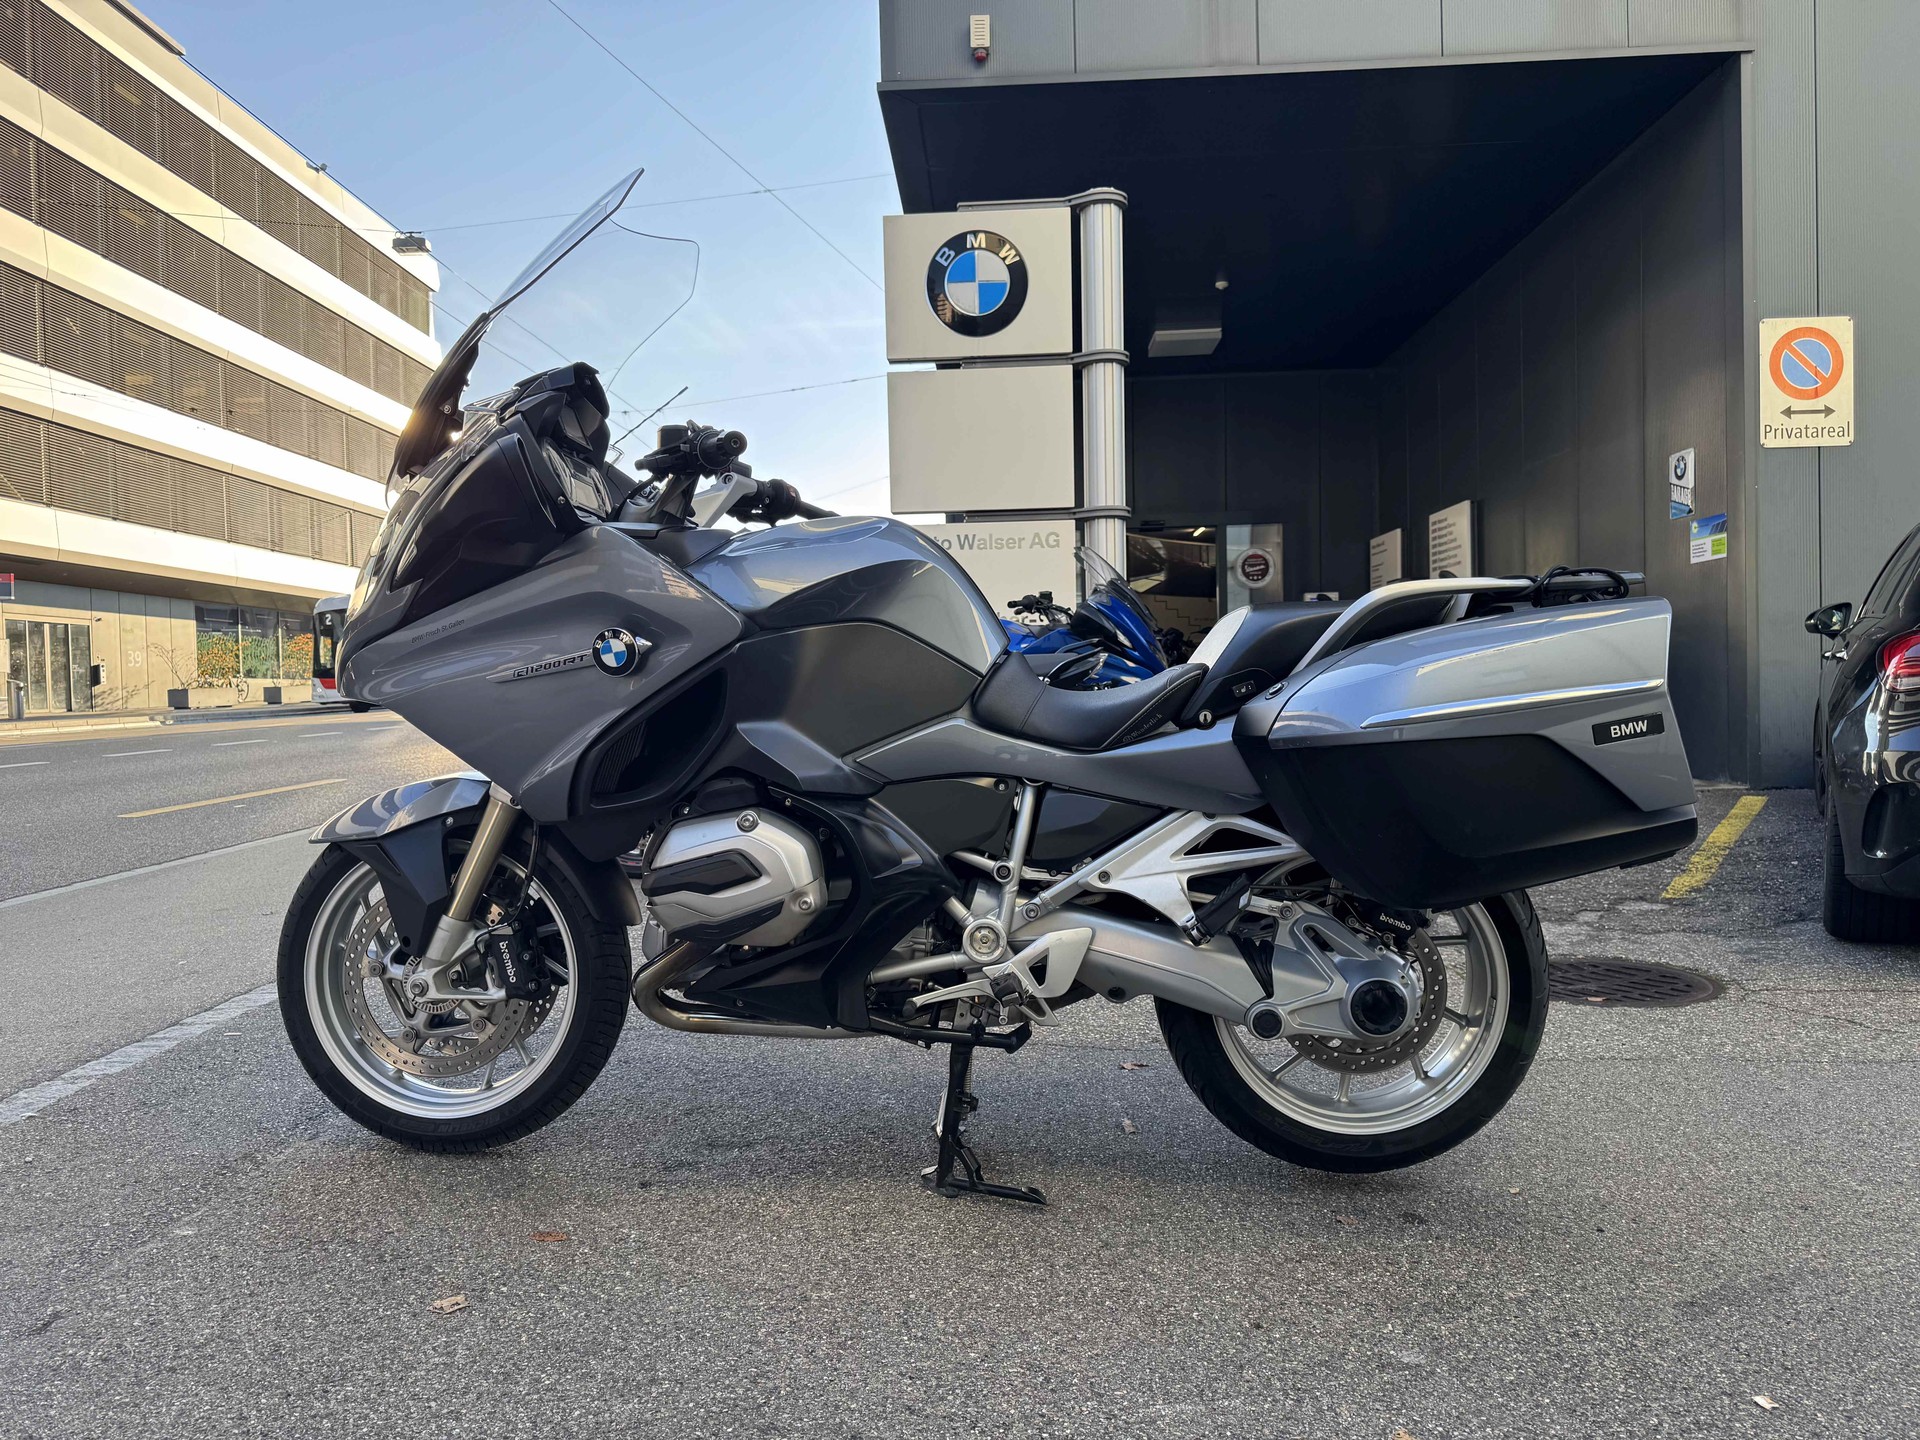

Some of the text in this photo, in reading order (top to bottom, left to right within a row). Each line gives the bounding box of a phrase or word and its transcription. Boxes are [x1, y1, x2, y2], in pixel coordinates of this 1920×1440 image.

[935, 232, 1020, 267] BMW
[1764, 421, 1850, 440] Privatareal
[956, 533, 1025, 551] Walser
[1029, 531, 1061, 549] AG
[325, 613, 332, 626] 2
[595, 630, 634, 649] BMW
[127, 650, 142, 667] 39
[1610, 719, 1648, 738] BMW
[1380, 912, 1411, 931] brembo
[499, 940, 516, 983] brembo
